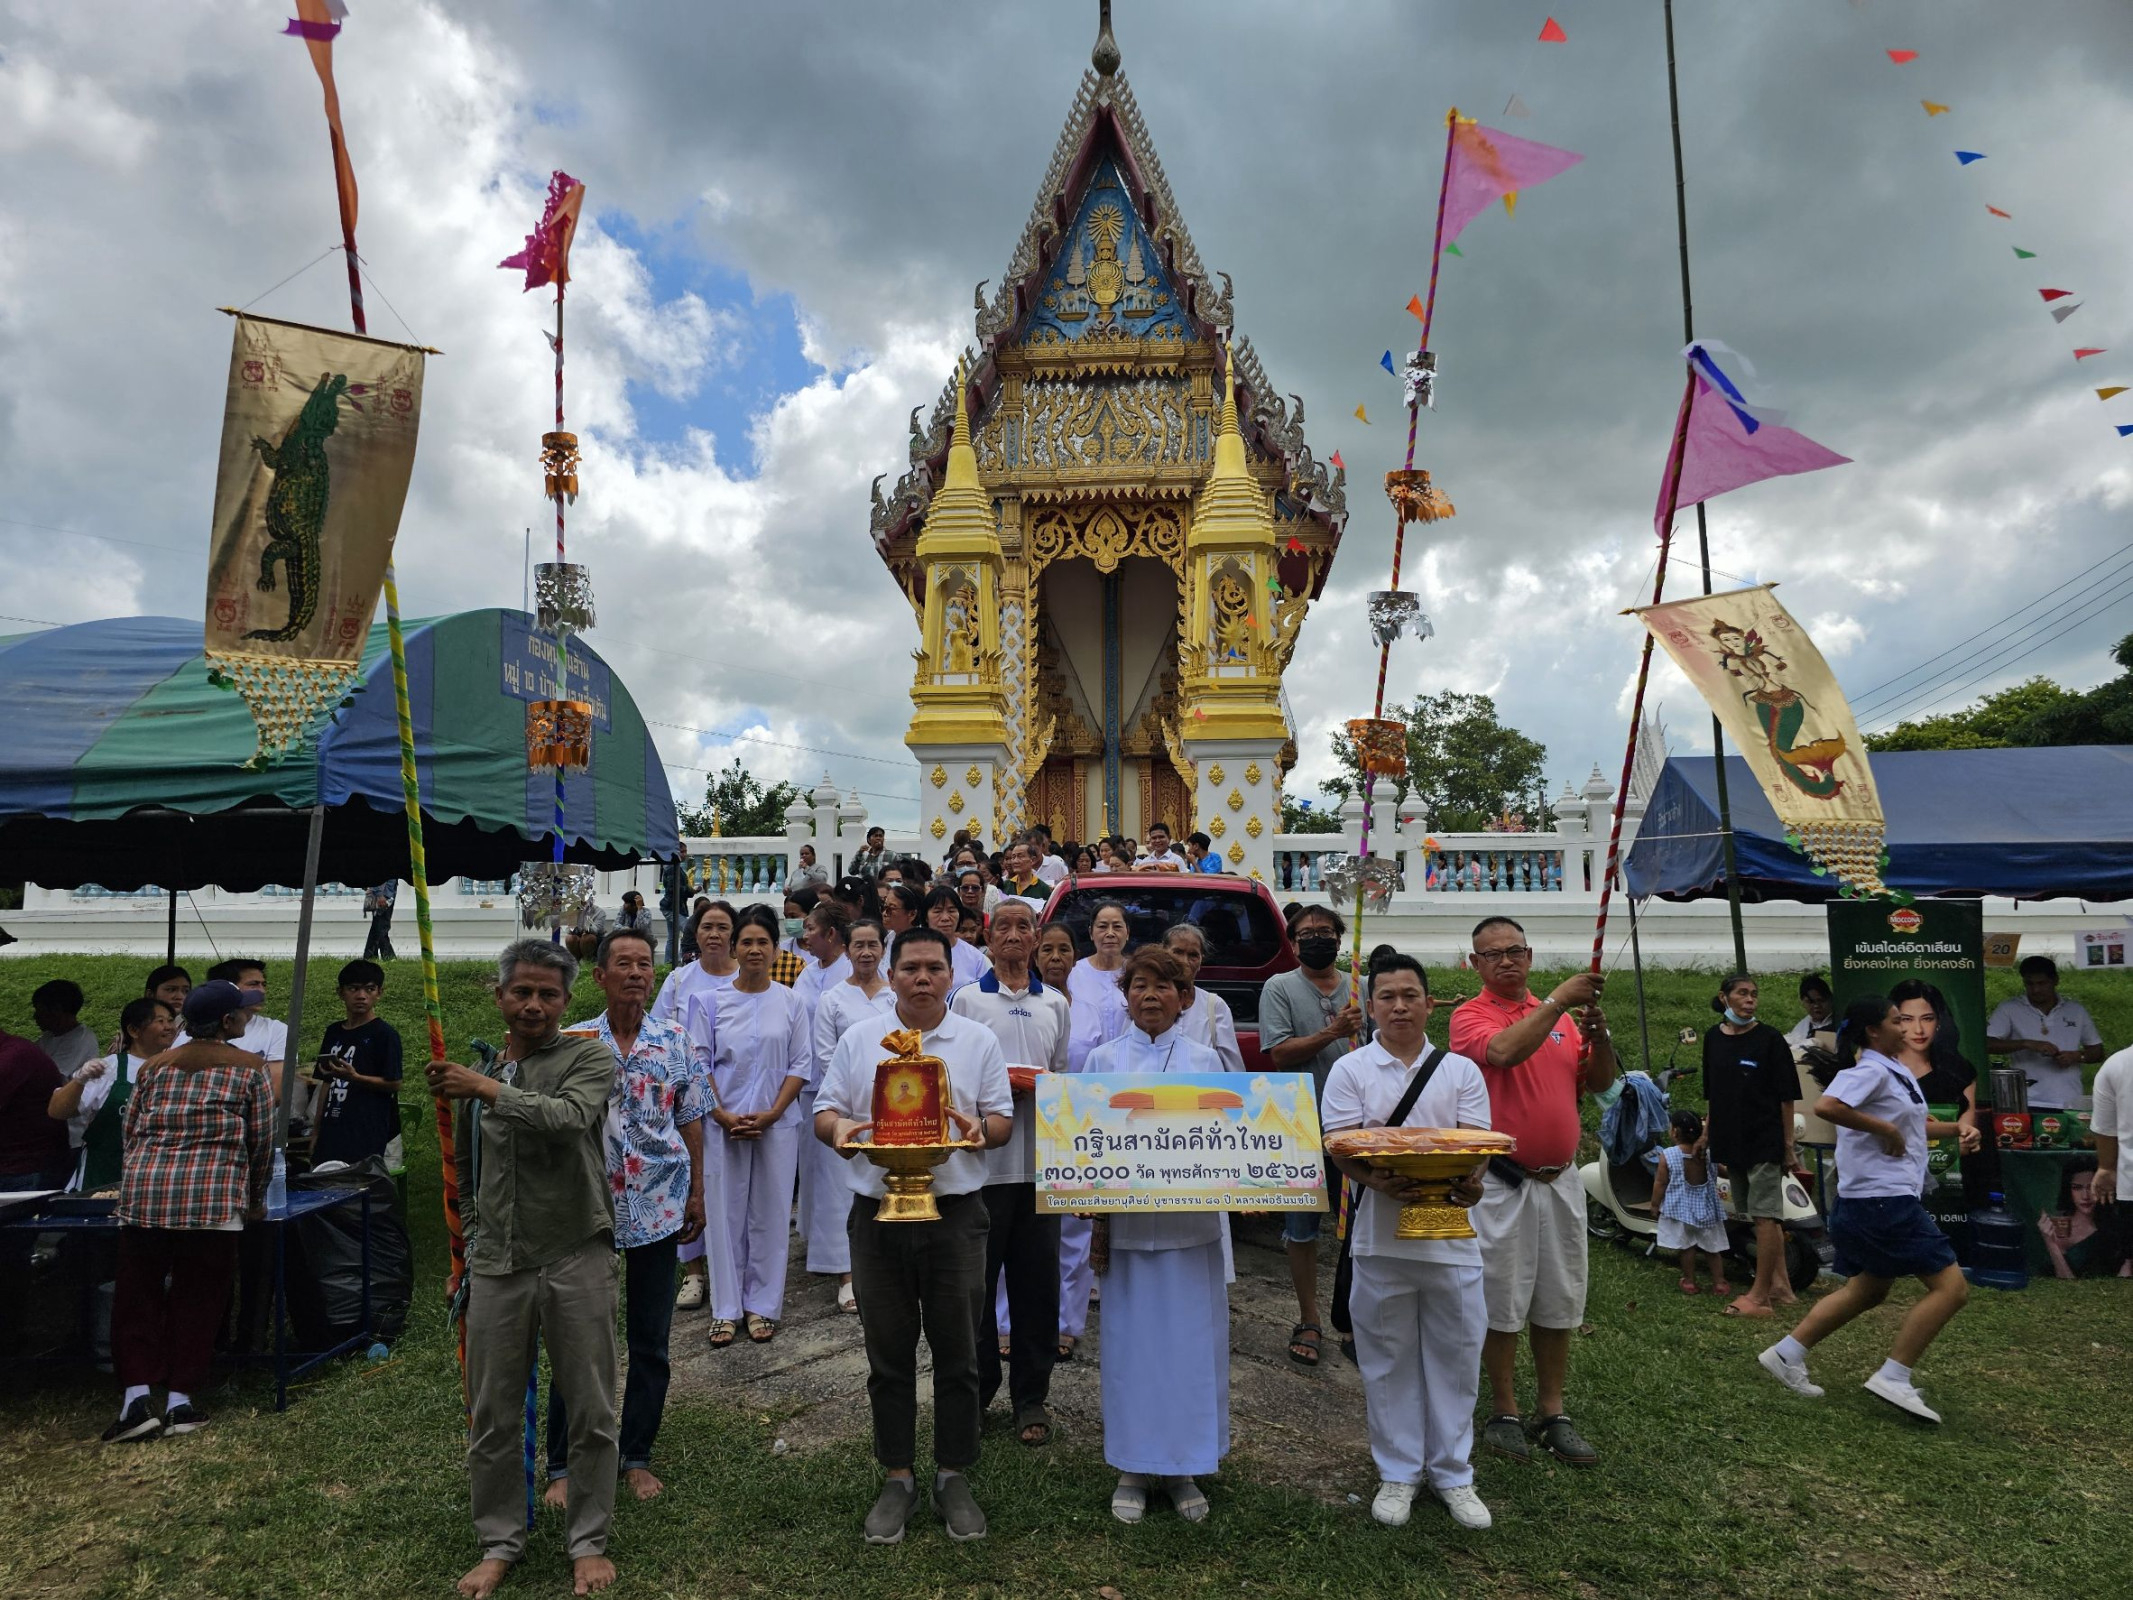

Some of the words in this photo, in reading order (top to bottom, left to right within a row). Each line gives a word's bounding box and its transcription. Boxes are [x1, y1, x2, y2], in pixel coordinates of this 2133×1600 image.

[504, 659, 519, 694] หมู่
[1855, 941, 1962, 953] เข้มสไตล์อิตาเลียน
[1992, 944, 2010, 954] 20
[1844, 955, 1909, 968] ยิ่งหลงใหล
[1914, 955, 1975, 968] ยิ่งหลงรัก
[1008, 1007, 1032, 1018] adidas
[1074, 1121, 1283, 1158] กฐินสามัคคีทั่วไทย
[1045, 1166, 1130, 1184] ๓๐,๐๐๐
[1136, 1163, 1155, 1179] วัด
[1159, 1163, 1241, 1184] พุทธศักราช
[1246, 1162, 1317, 1178] ๒๕๖๘
[1047, 1196, 1067, 1207] โดย
[1154, 1197, 1201, 1207] บูชาธรรม
[1224, 1194, 1231, 1205] ปี
